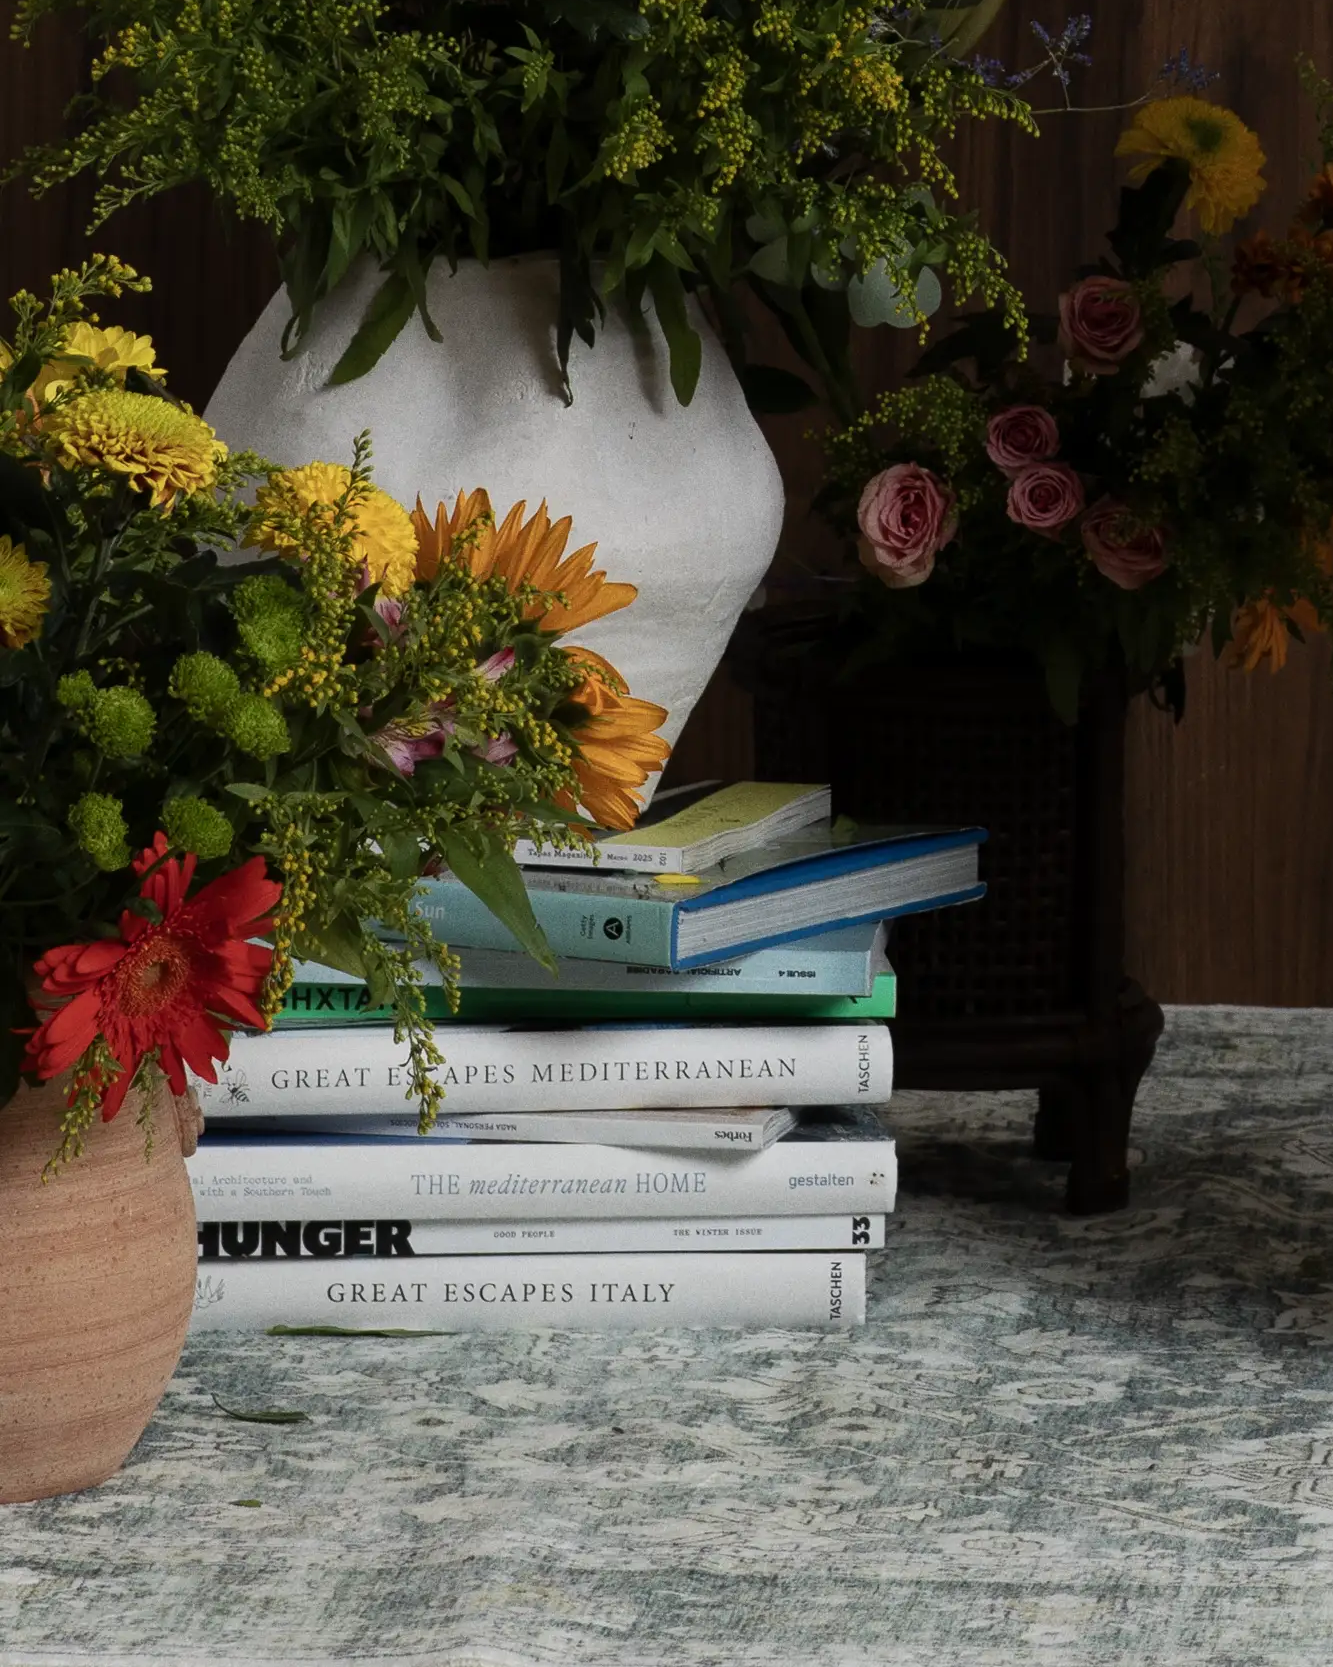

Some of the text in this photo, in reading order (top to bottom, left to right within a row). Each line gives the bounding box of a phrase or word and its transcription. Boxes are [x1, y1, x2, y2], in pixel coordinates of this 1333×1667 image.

[633, 853, 652, 862] 2025
[415, 901, 445, 919] Sun
[858, 1034, 869, 1094] TASCHEN
[271, 1058, 797, 1090] GREAT ESAPES MEDITERRANEAN
[714, 1130, 753, 1142] Forbes
[212, 1175, 287, 1185] Architecture
[410, 1172, 707, 1196] THE mediterranean HOME
[788, 1174, 854, 1189] gestalten
[200, 1187, 225, 1197] with
[243, 1187, 295, 1197] Southern
[300, 1187, 332, 1197] Touch
[198, 1220, 415, 1256] HUNGER
[493, 1230, 555, 1238] GOOD PEOPLE
[673, 1228, 763, 1236] THE WINTER ISSUE
[852, 1216, 870, 1245] 33
[327, 1282, 676, 1303] GREAT ESCAPES ITALY
[830, 1261, 842, 1321] TASCHEN
